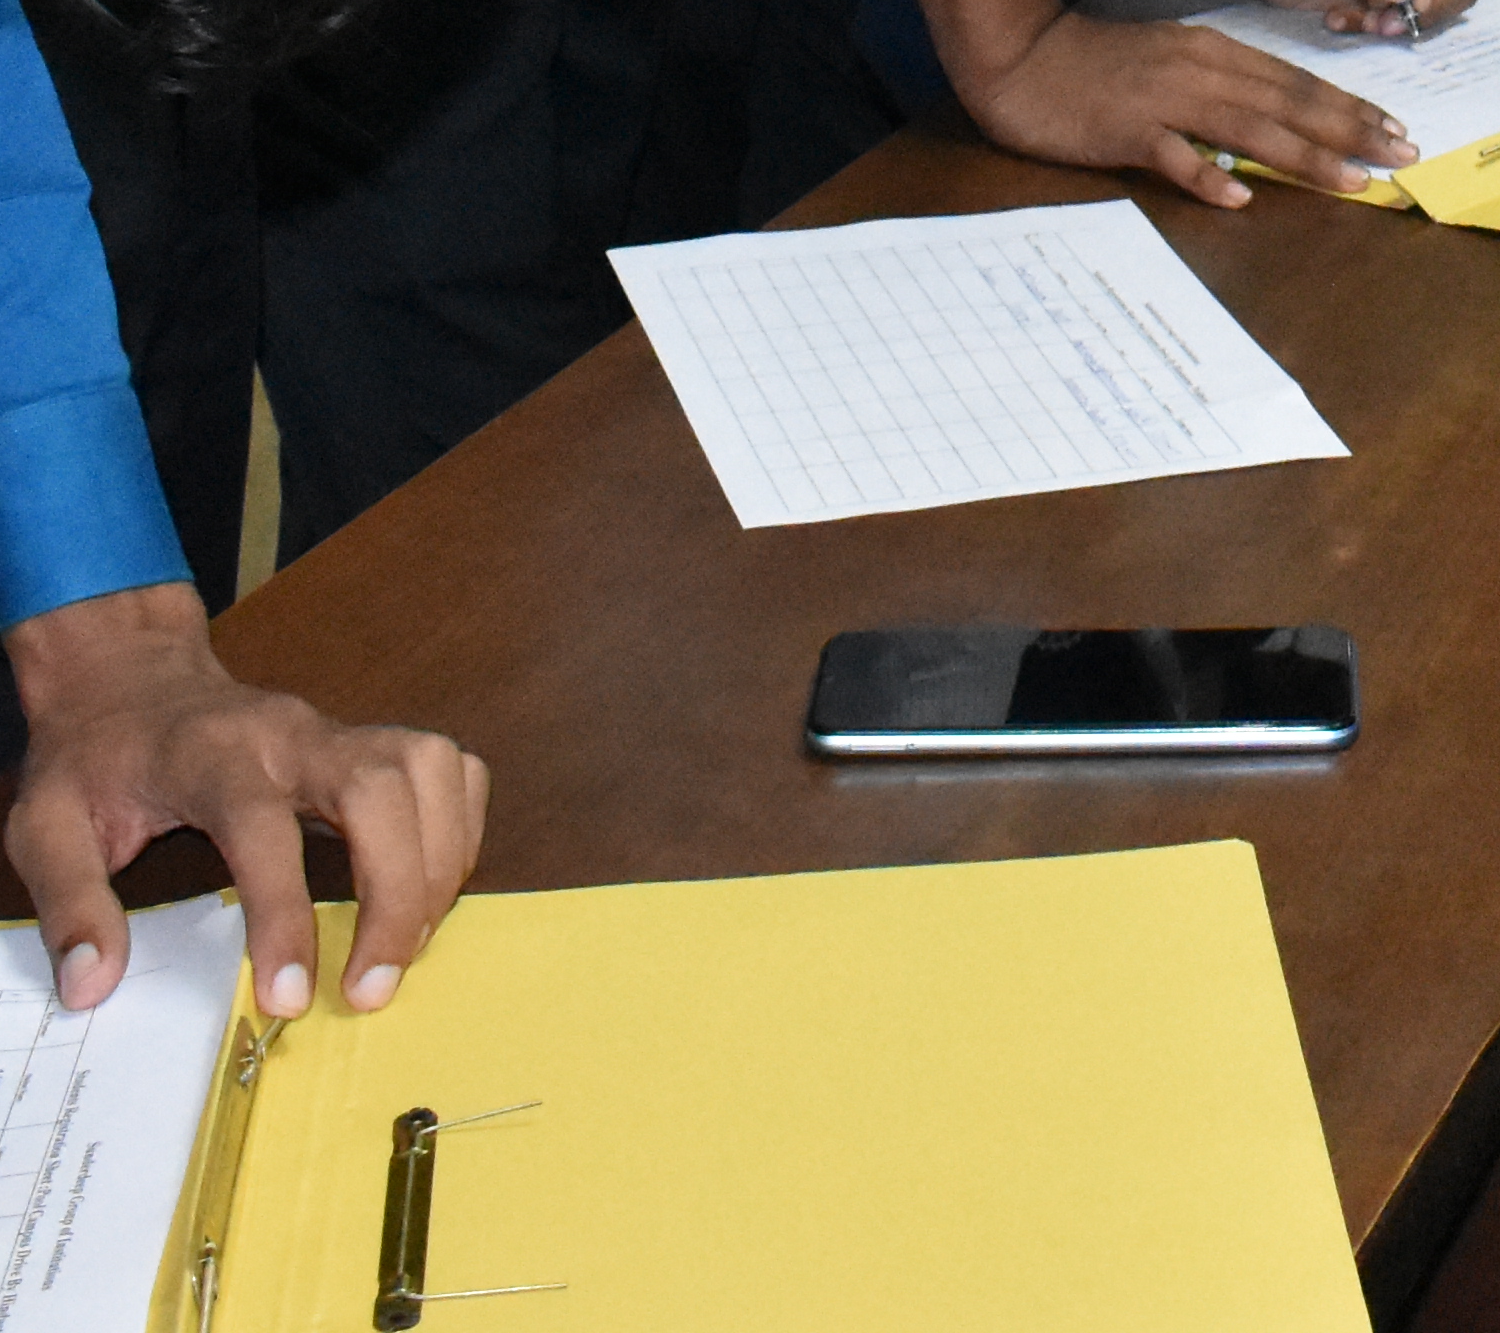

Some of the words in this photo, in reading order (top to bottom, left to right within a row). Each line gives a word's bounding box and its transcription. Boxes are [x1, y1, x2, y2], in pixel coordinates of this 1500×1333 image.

[66, 1069, 91, 1106] Students
[49, 1106, 79, 1159] Registration
[16, 1209, 44, 1248] Campus
[59, 1196, 85, 1225] Group
[10, 1250, 32, 1277] Drive
[41, 1238, 72, 1291] Institutions
